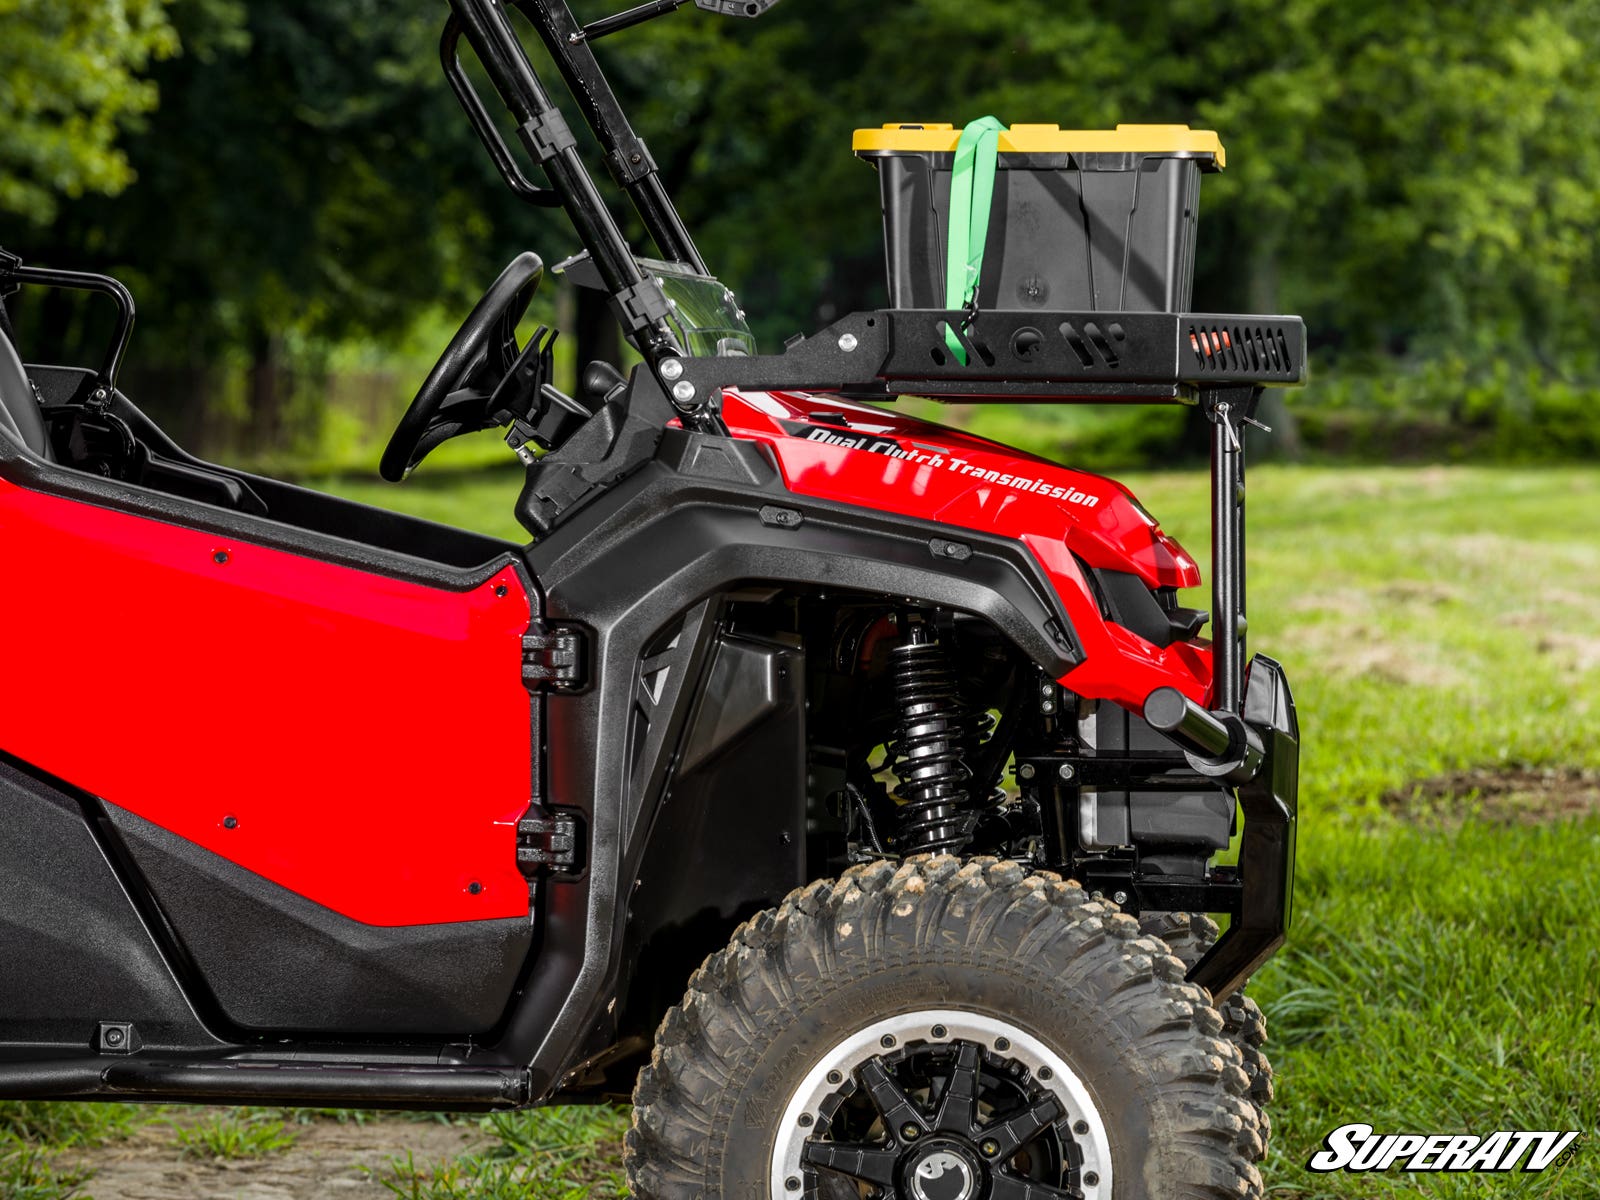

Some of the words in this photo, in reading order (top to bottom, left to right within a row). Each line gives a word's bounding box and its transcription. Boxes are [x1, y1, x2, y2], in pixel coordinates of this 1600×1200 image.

[806, 428, 866, 449] Dual
[867, 441, 944, 467] Clutch
[947, 457, 1099, 507] Transmission
